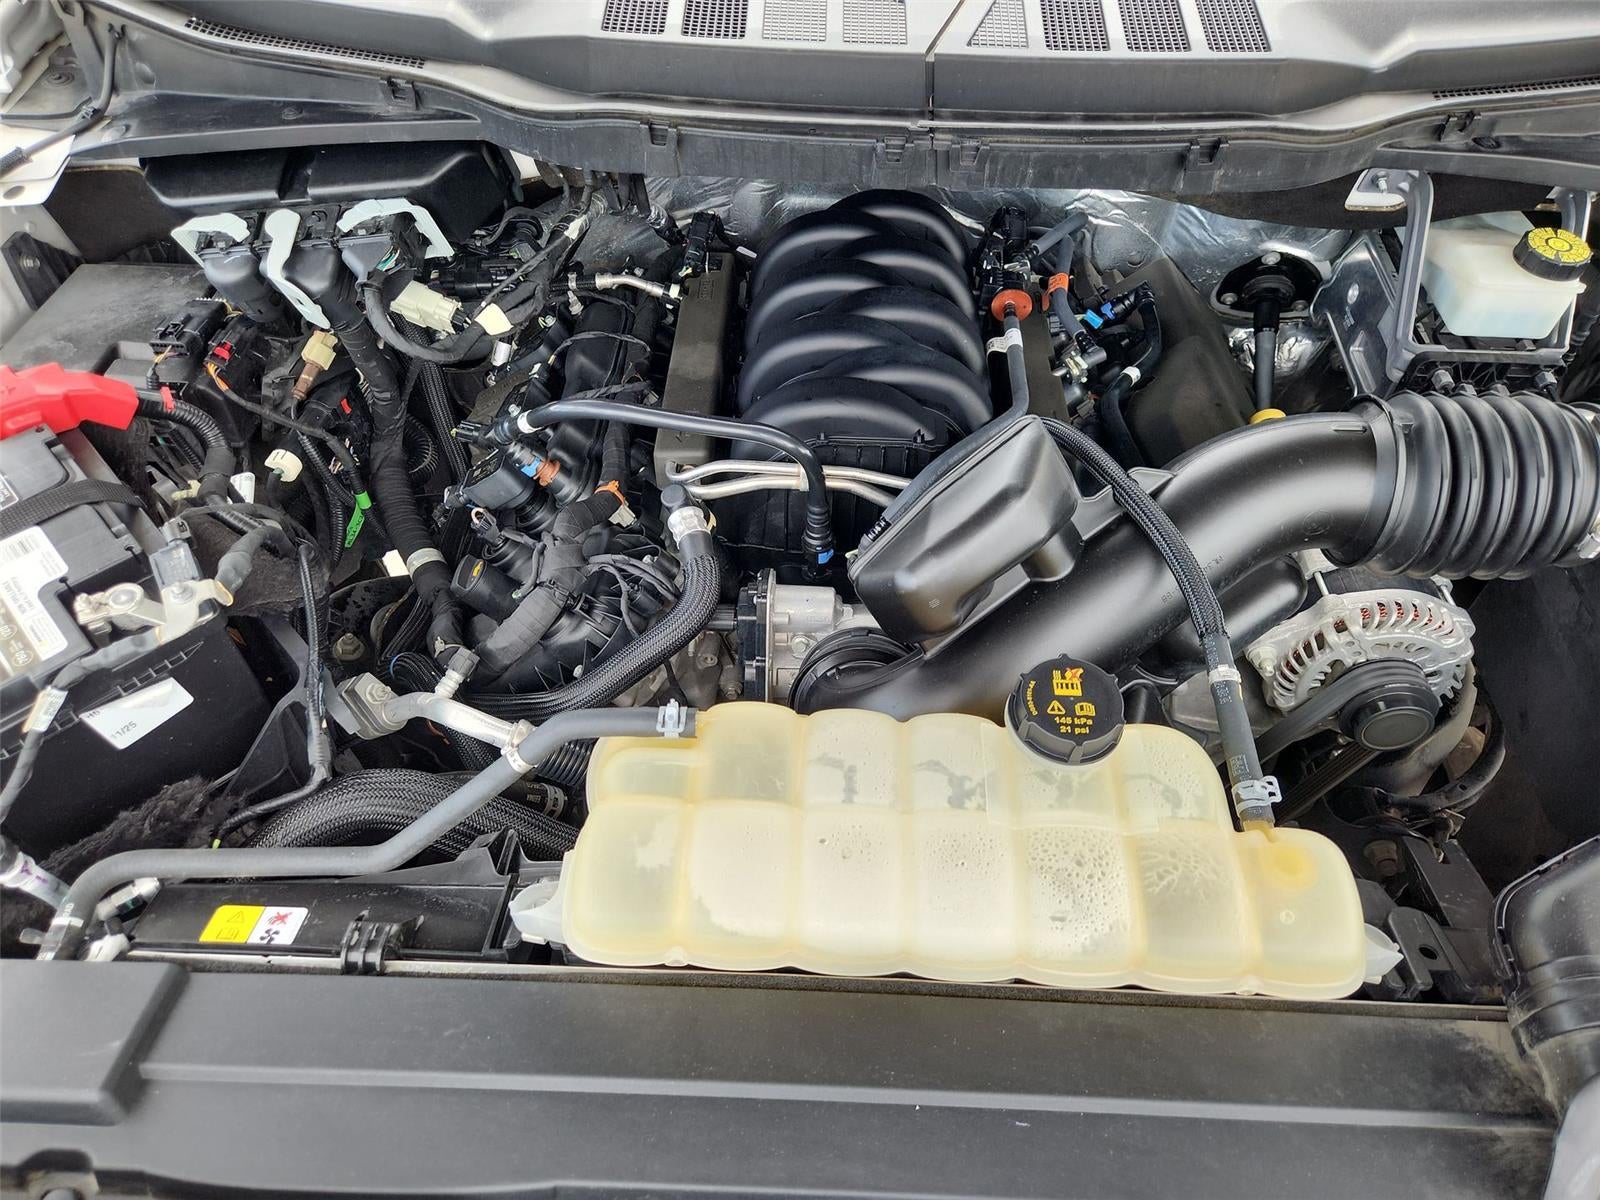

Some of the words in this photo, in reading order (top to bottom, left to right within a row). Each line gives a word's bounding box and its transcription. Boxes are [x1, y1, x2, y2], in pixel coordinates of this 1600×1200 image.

[1054, 715, 1073, 725] 145
[1074, 716, 1093, 726] kPa
[1059, 725, 1072, 734] 21
[1074, 726, 1090, 735] psi
